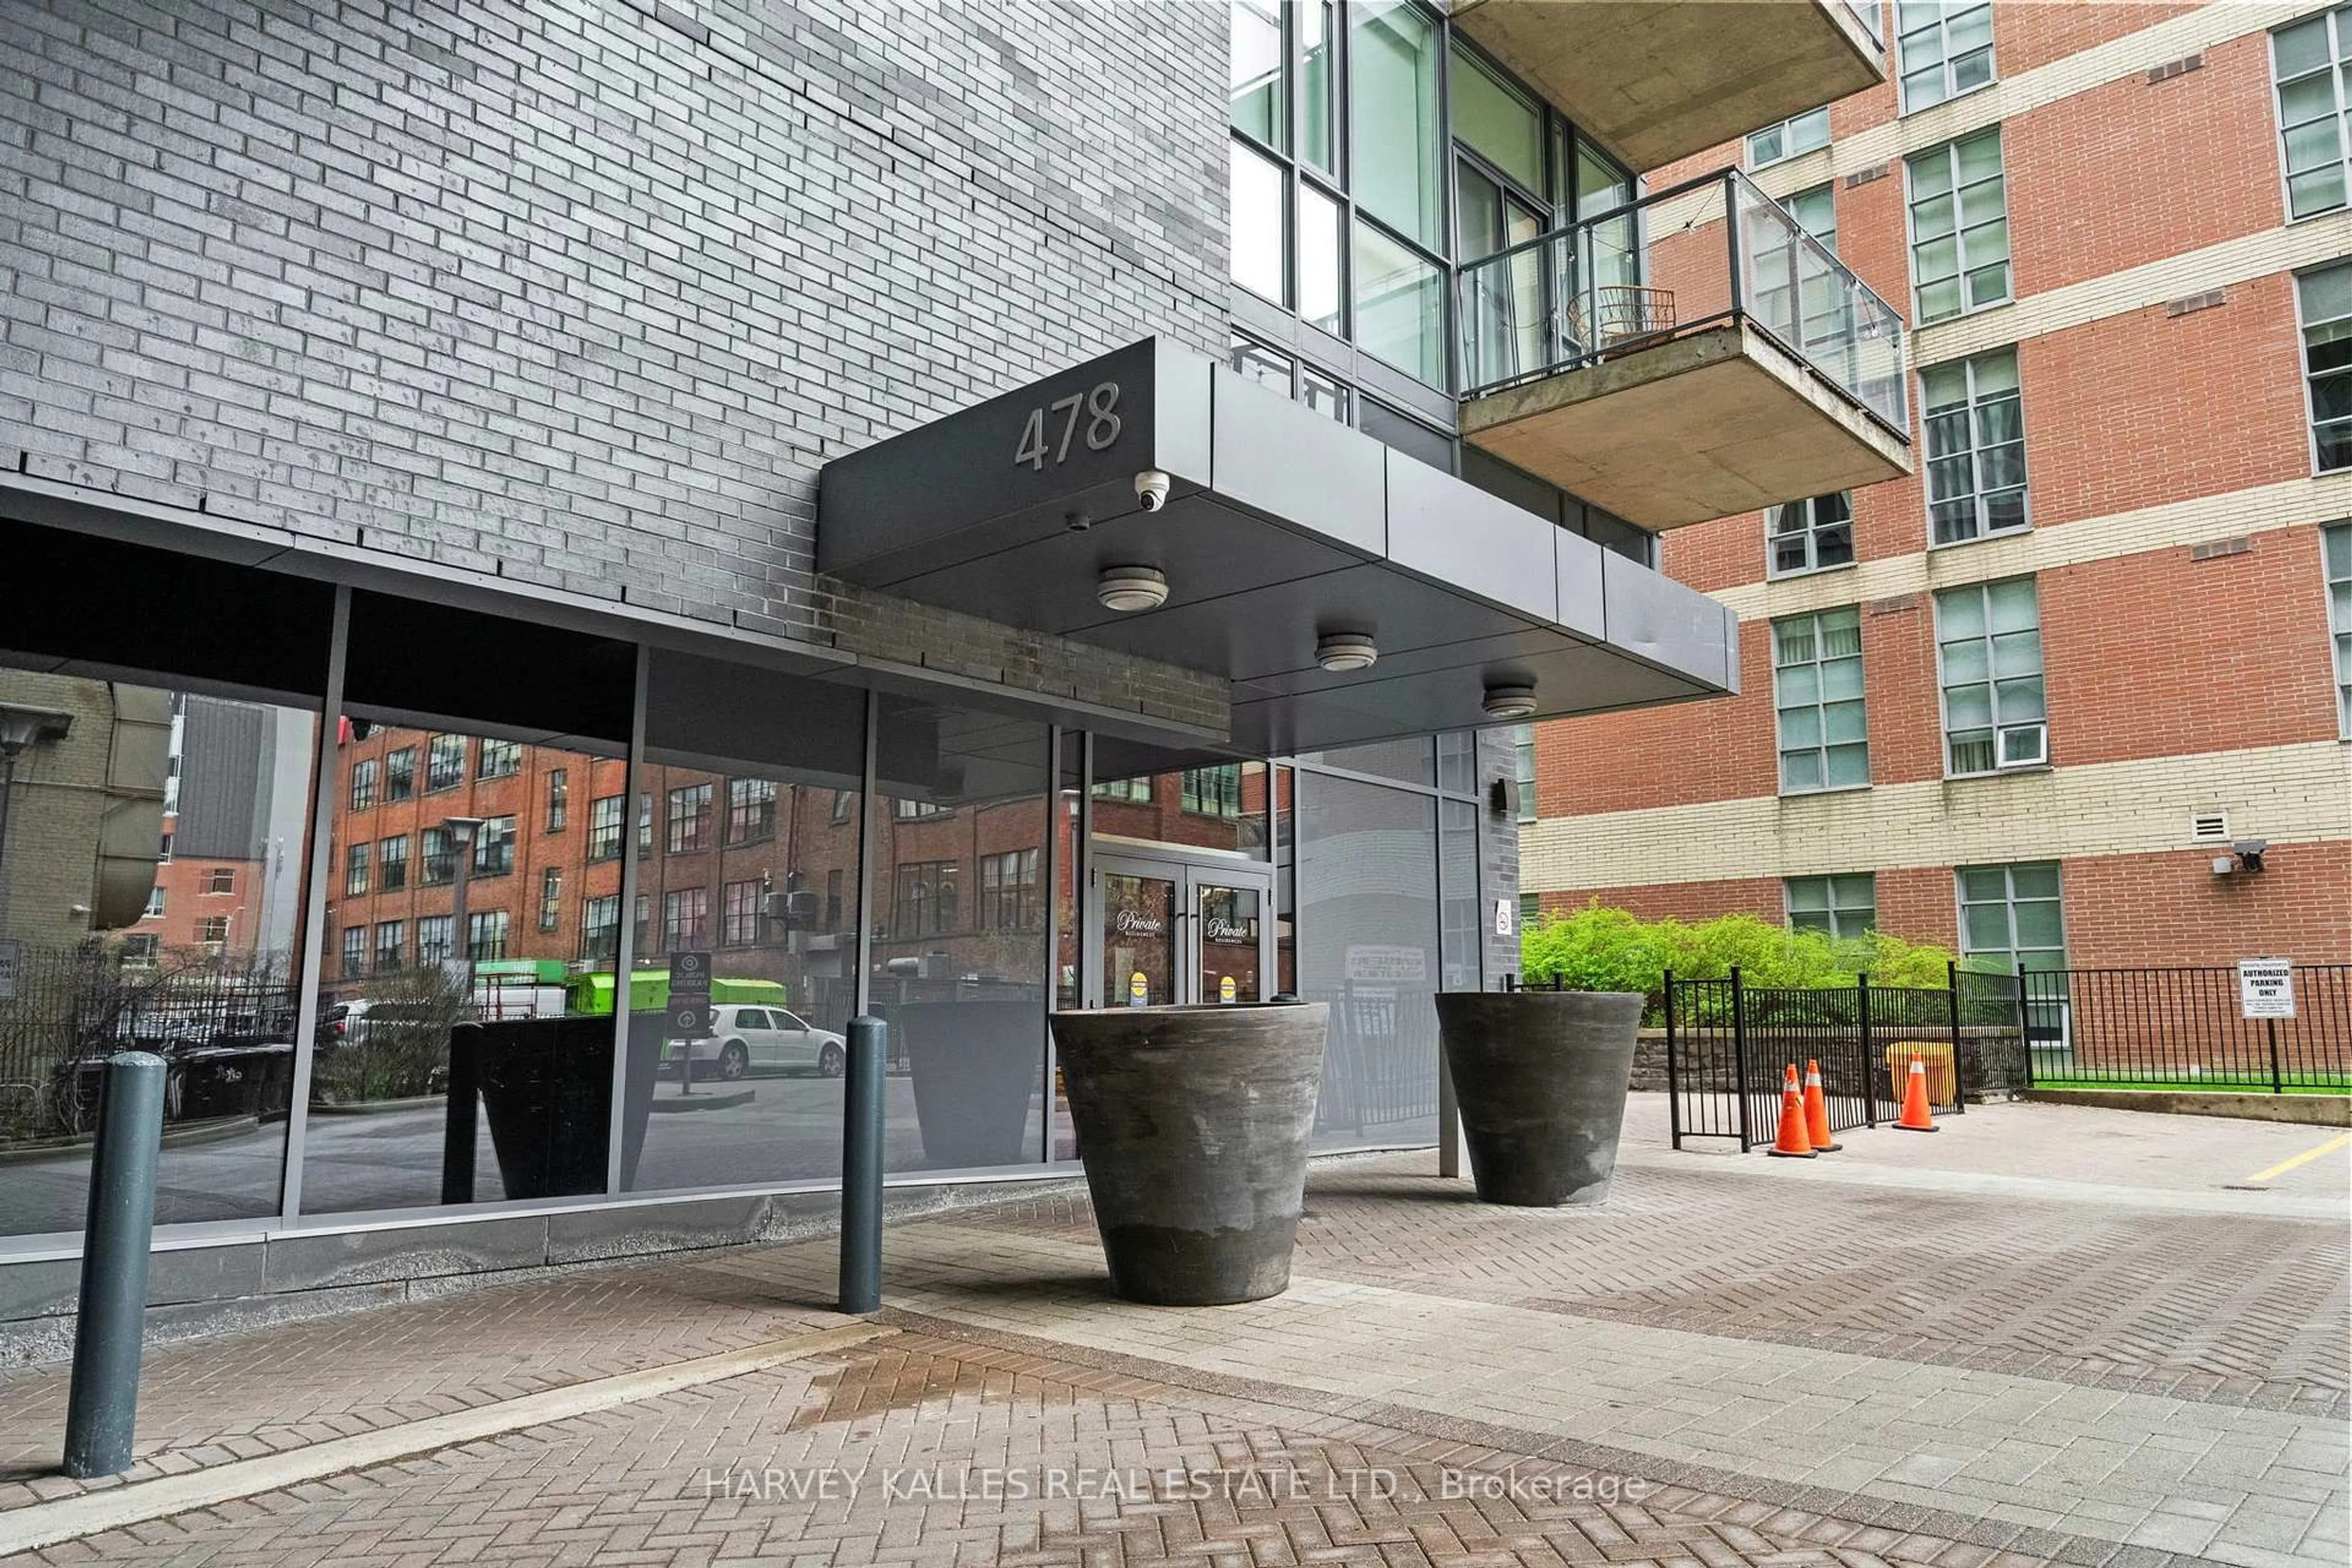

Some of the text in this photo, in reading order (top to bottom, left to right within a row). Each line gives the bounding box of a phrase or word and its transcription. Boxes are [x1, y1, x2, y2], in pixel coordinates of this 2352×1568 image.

[1014, 382, 1120, 471] 478
[1117, 910, 1161, 930] Private
[1208, 918, 1247, 937] Private
[2244, 969, 2289, 978] AUTHORIZED
